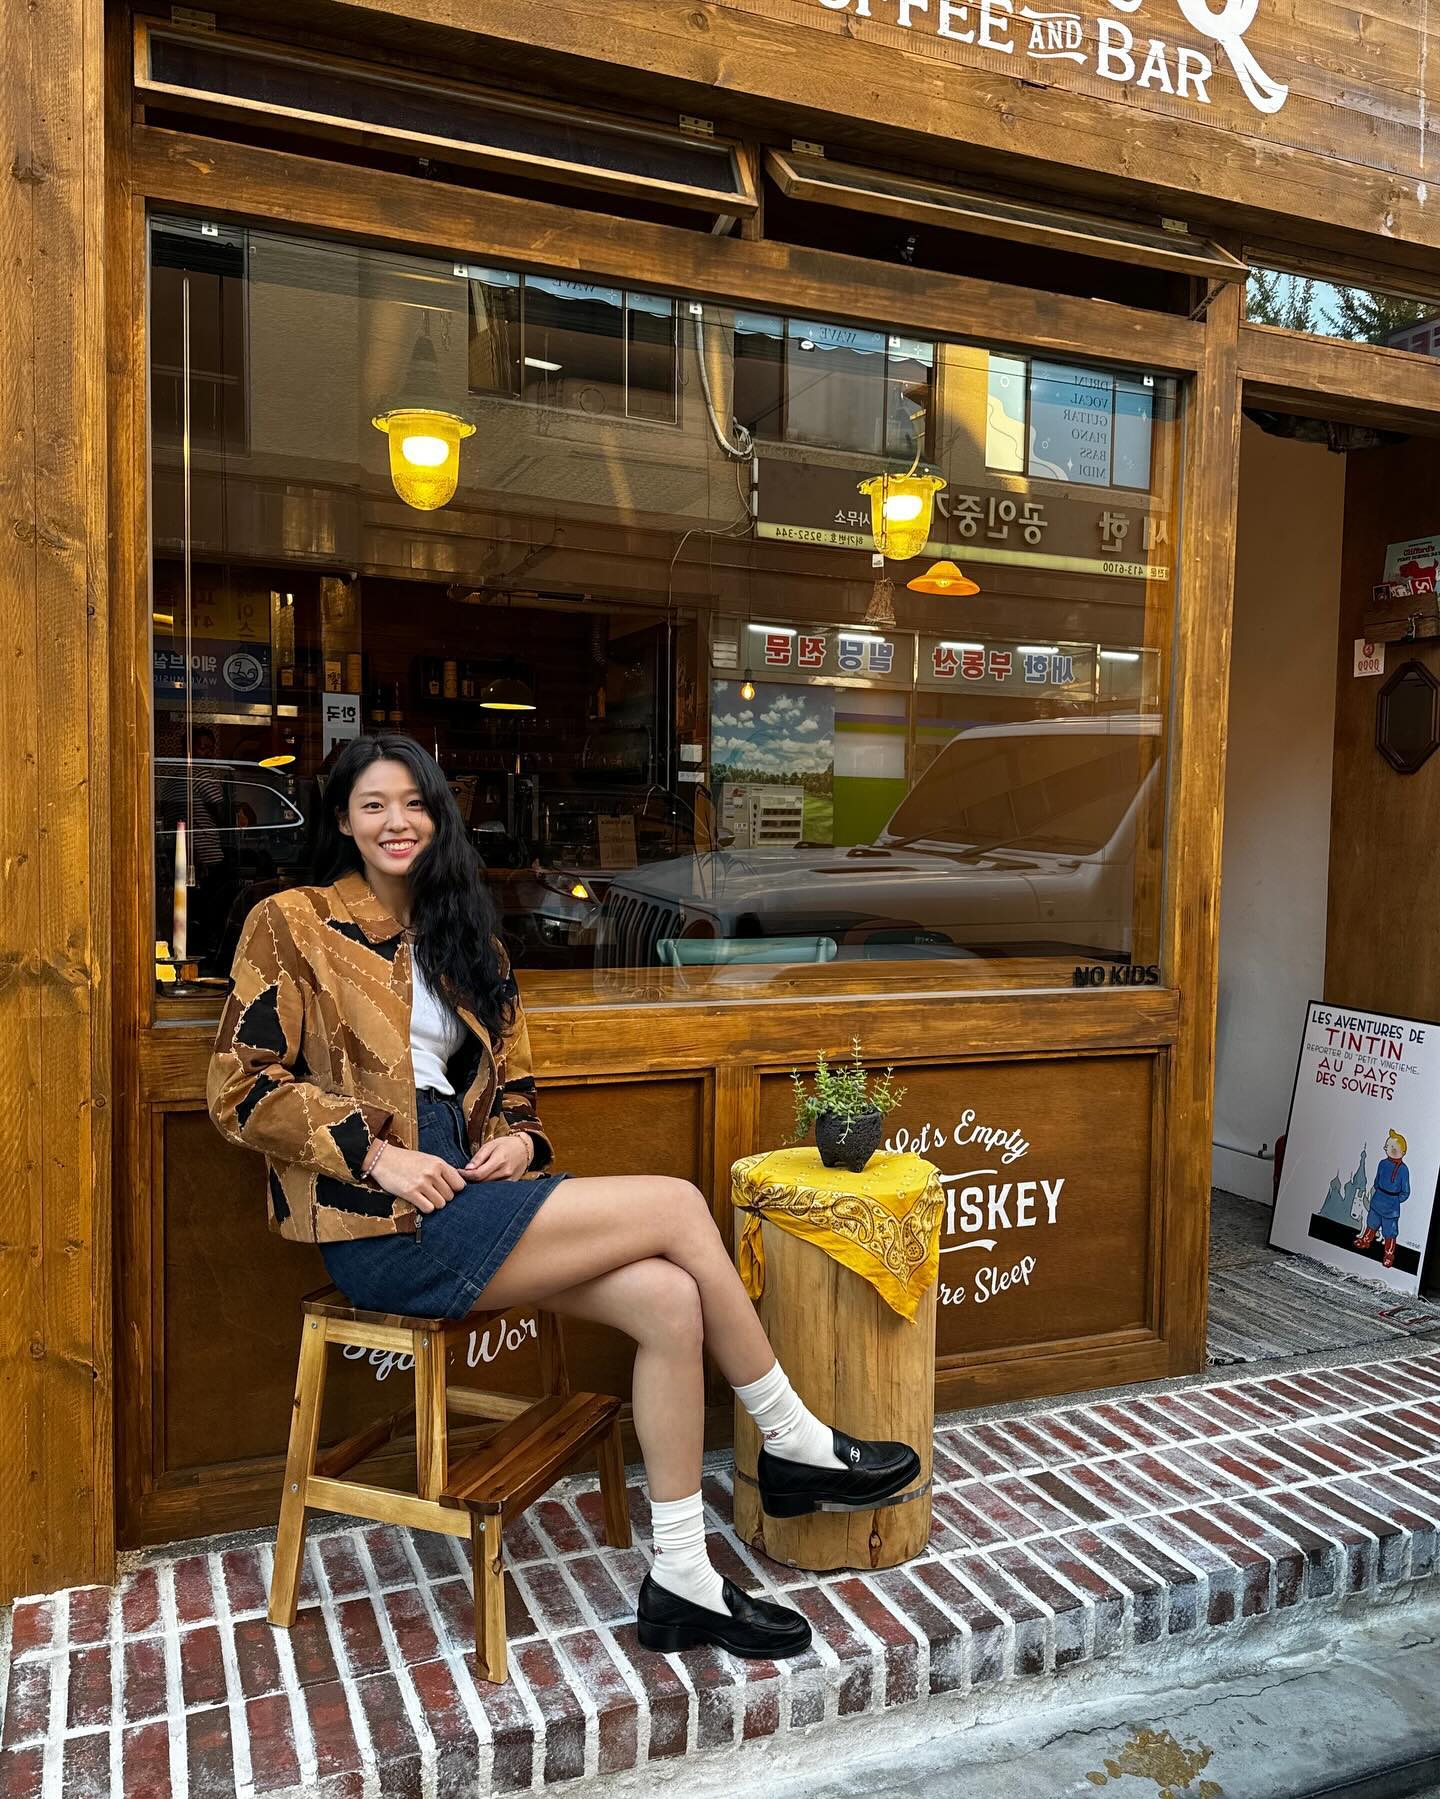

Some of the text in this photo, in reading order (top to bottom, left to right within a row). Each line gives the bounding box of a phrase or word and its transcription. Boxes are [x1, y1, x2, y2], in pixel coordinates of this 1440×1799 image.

[1027, 19, 1083, 50] AND
[1095, 17, 1214, 104] BAR
[1073, 965, 1160, 987] NO KIDS
[1312, 1010, 1426, 1044] LES AVENTURES DE
[1325, 1027, 1403, 1061] TINTIN
[1306, 1043, 1342, 1057] REPORTER
[1344, 1052, 1353, 1060] DU
[1315, 1070, 1395, 1101] DES SOVIETS
[1318, 1056, 1398, 1086] AU PAYS
[884, 1108, 1031, 1165] Let's Empty
[939, 1178, 1066, 1235] ISKEY
[974, 1255, 1037, 1304] Sleep
[466, 1318, 538, 1369] Wor
